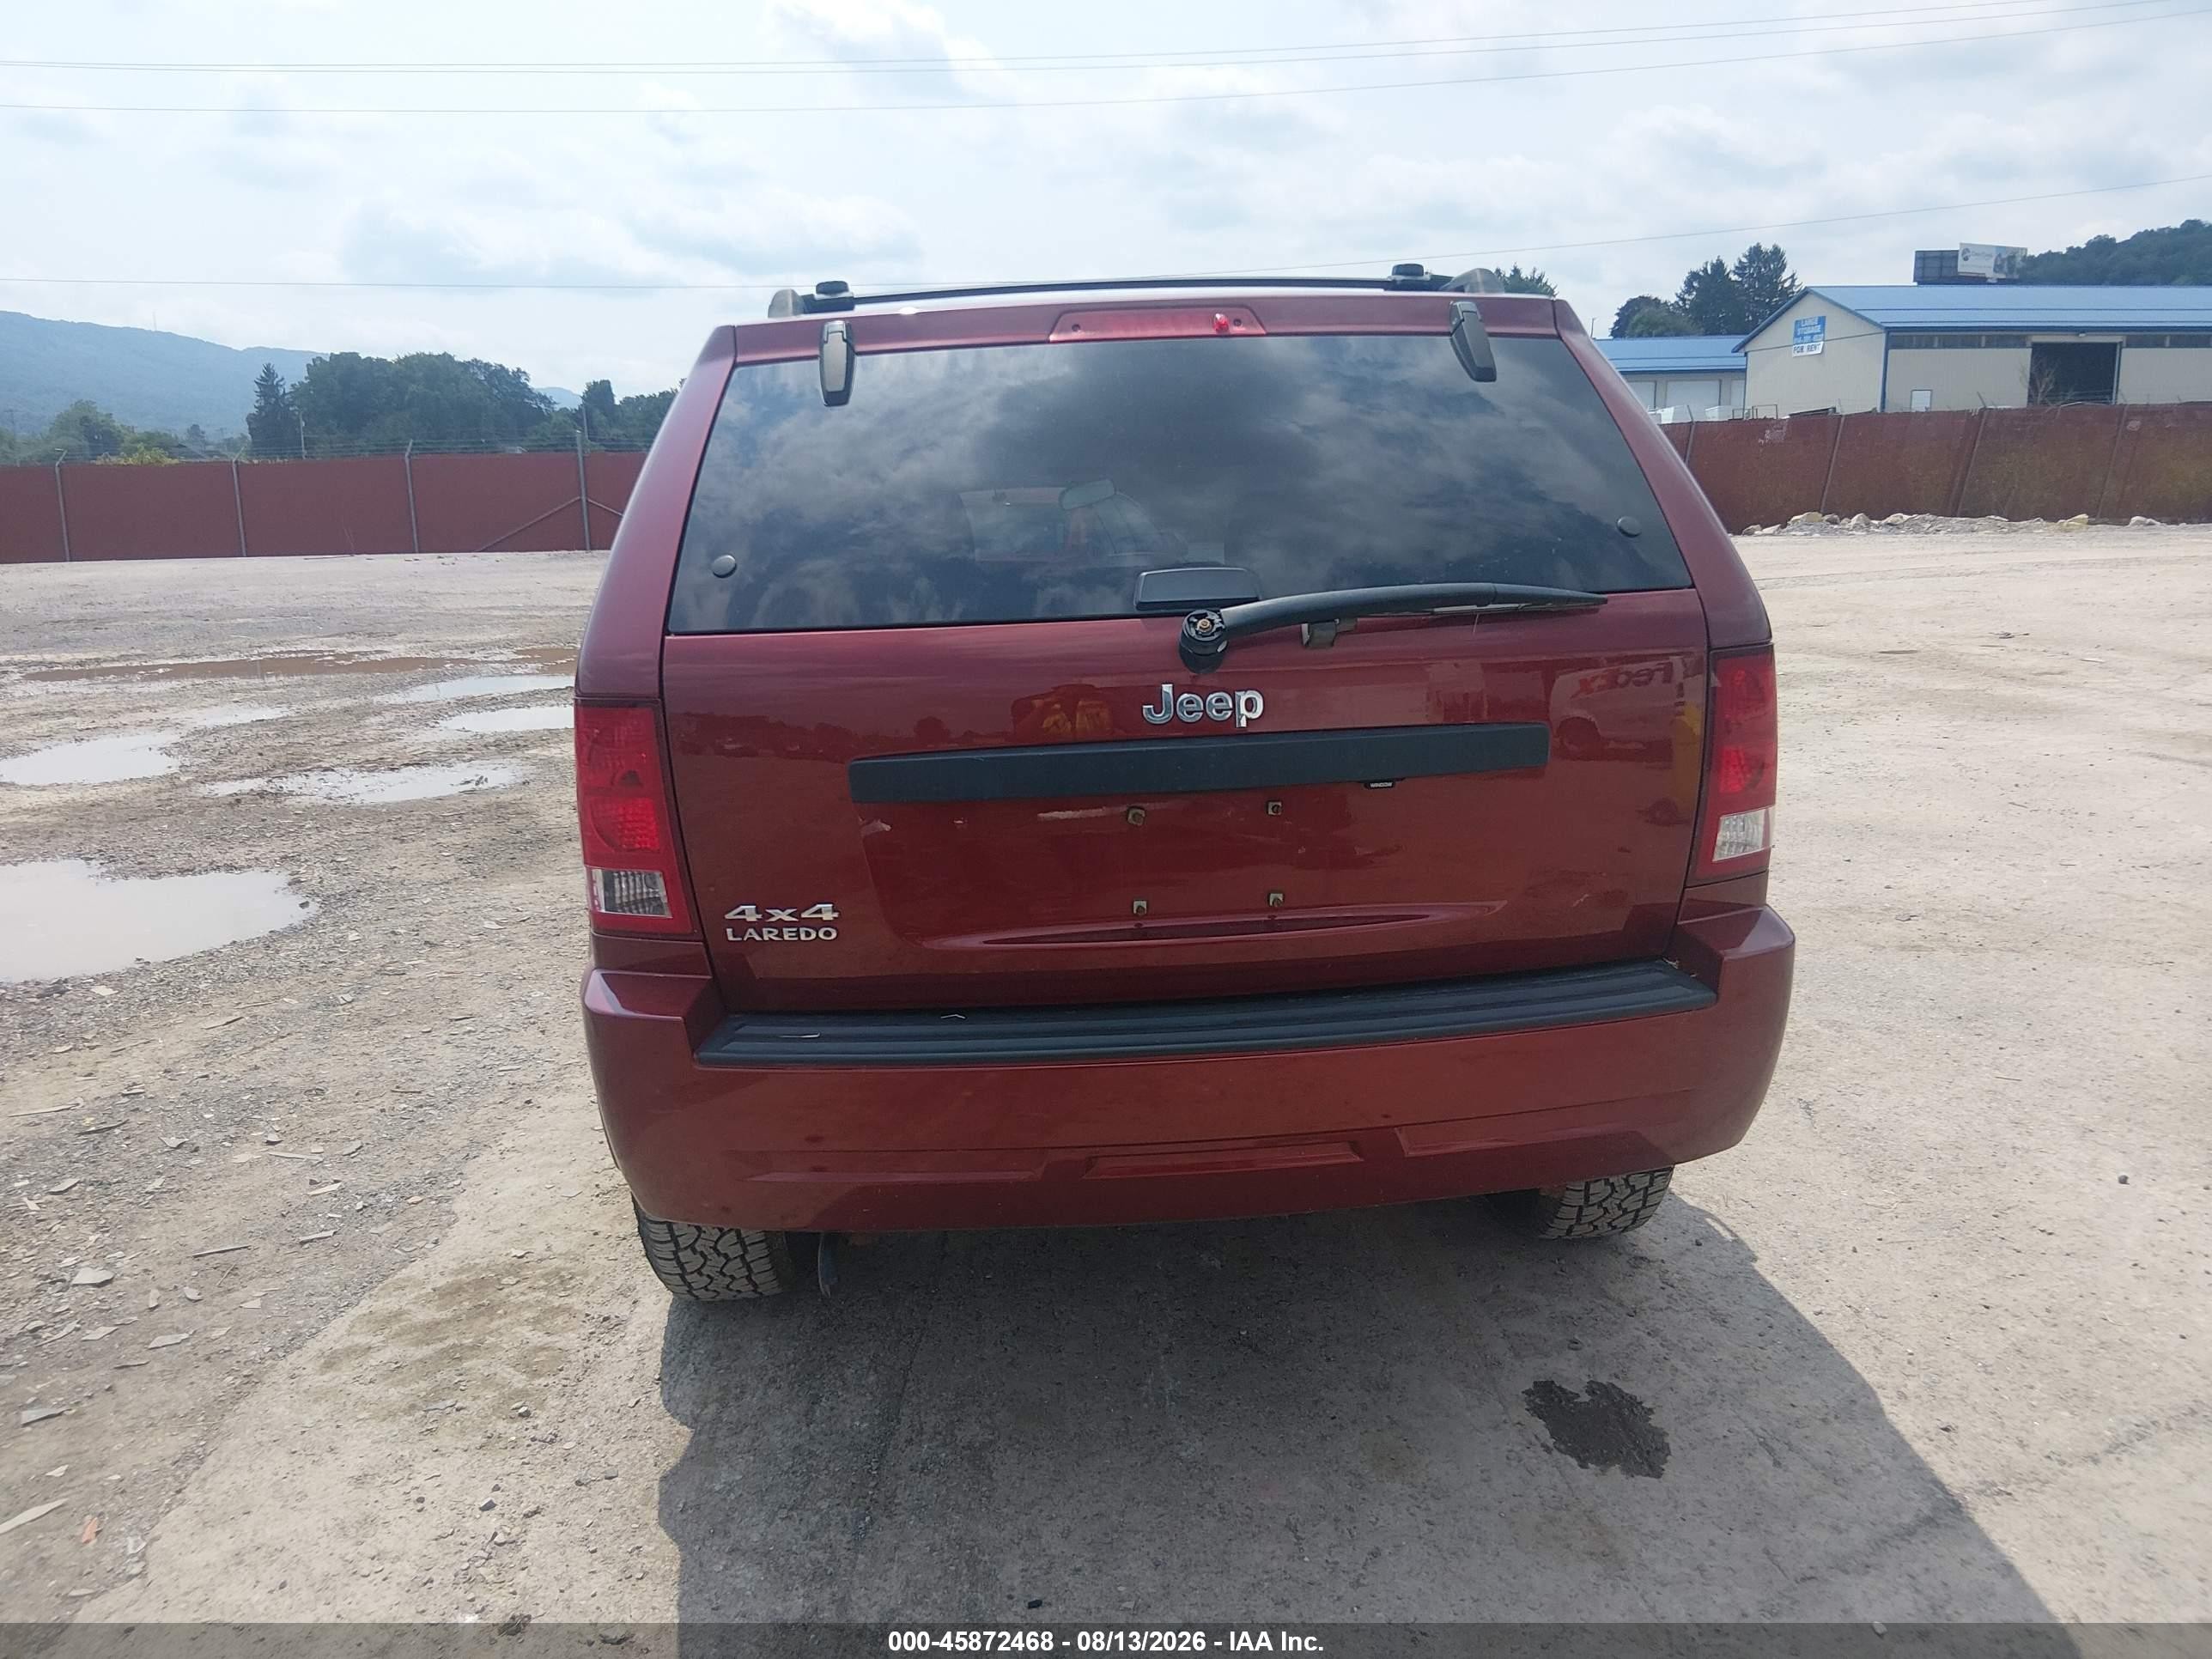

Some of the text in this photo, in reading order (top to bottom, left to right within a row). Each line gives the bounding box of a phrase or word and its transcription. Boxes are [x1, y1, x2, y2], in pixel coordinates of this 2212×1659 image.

[1806, 343, 1821, 352] RENT
[1142, 684, 1264, 728] Jeep
[724, 903, 840, 922] 4x4
[726, 927, 837, 941] LAREDO
